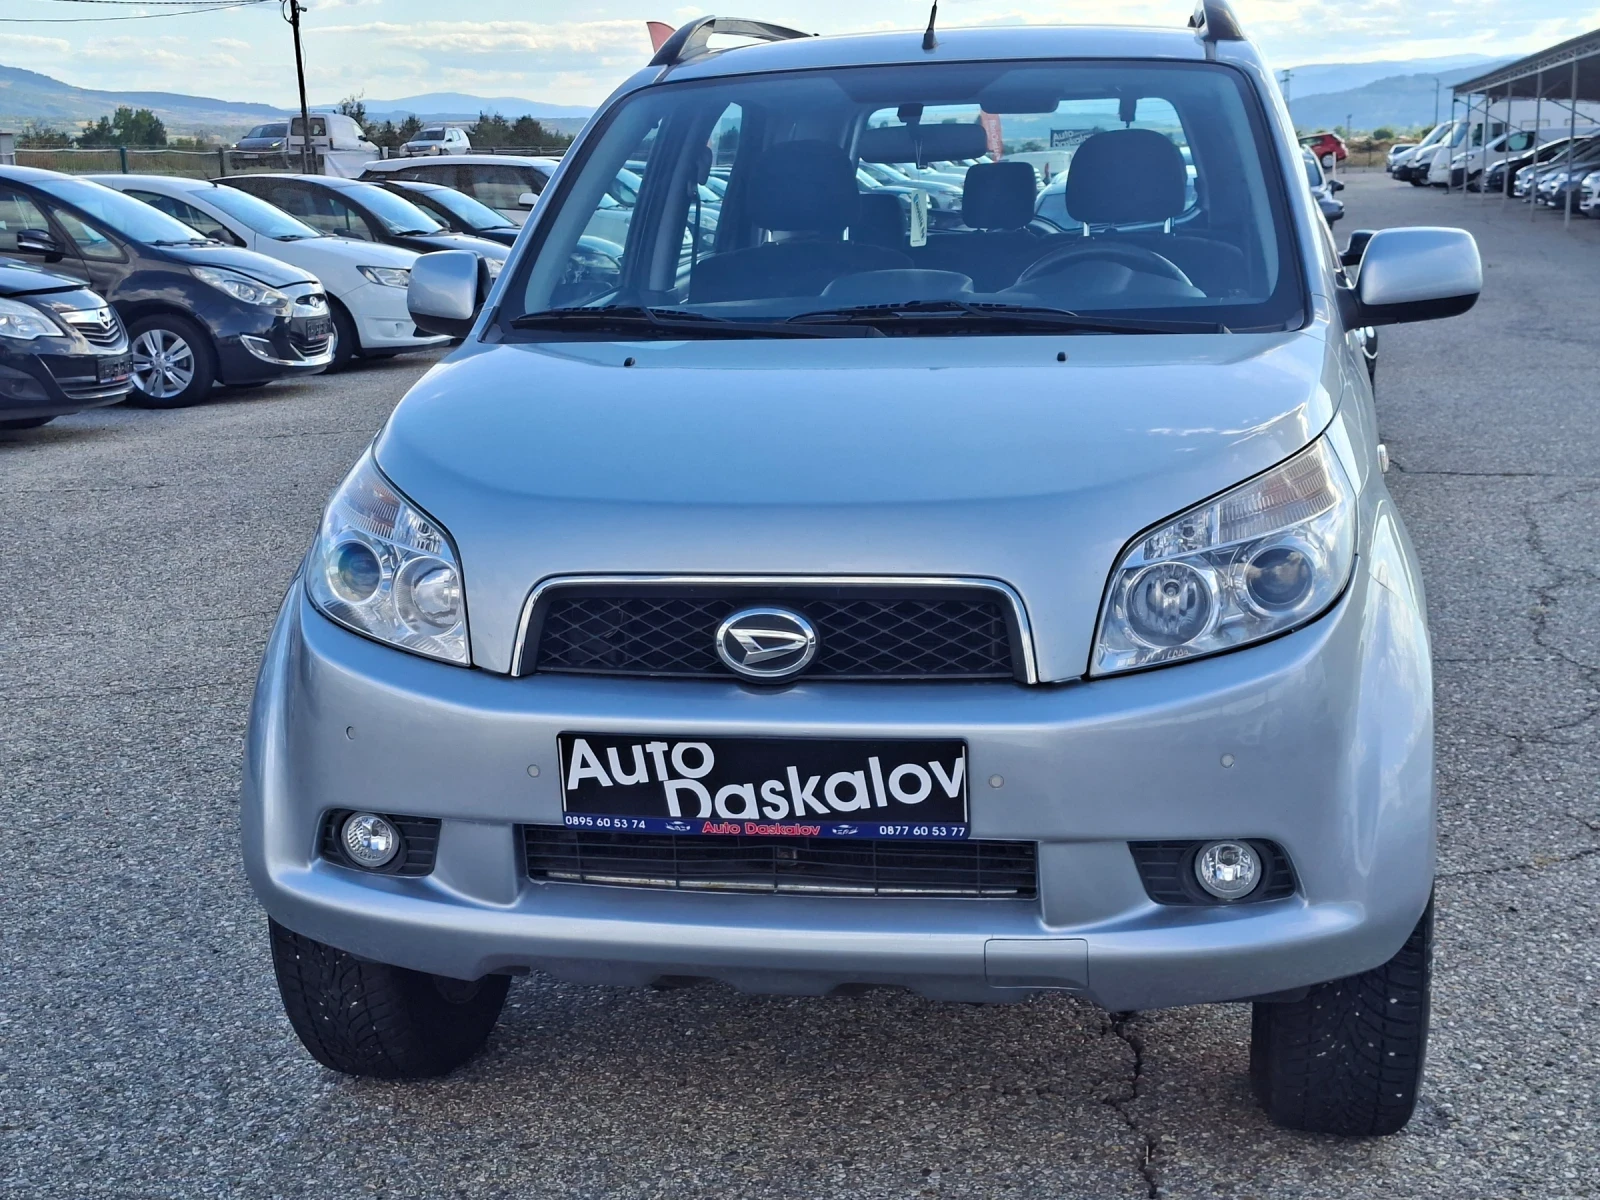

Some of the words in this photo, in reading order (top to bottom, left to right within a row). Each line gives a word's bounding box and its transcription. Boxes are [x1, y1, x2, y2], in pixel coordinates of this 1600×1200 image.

[567, 738, 715, 791] Auto
[663, 756, 965, 820] Daskalov
[565, 815, 593, 826] 0895
[596, 816, 611, 827] 60
[613, 818, 629, 829] 53
[631, 819, 646, 830] 74
[702, 820, 741, 835] Auto
[745, 822, 821, 837] Daskalov
[879, 825, 909, 836] 0877
[913, 825, 929, 836] 60
[931, 826, 947, 837] 53
[951, 826, 966, 838] 77
